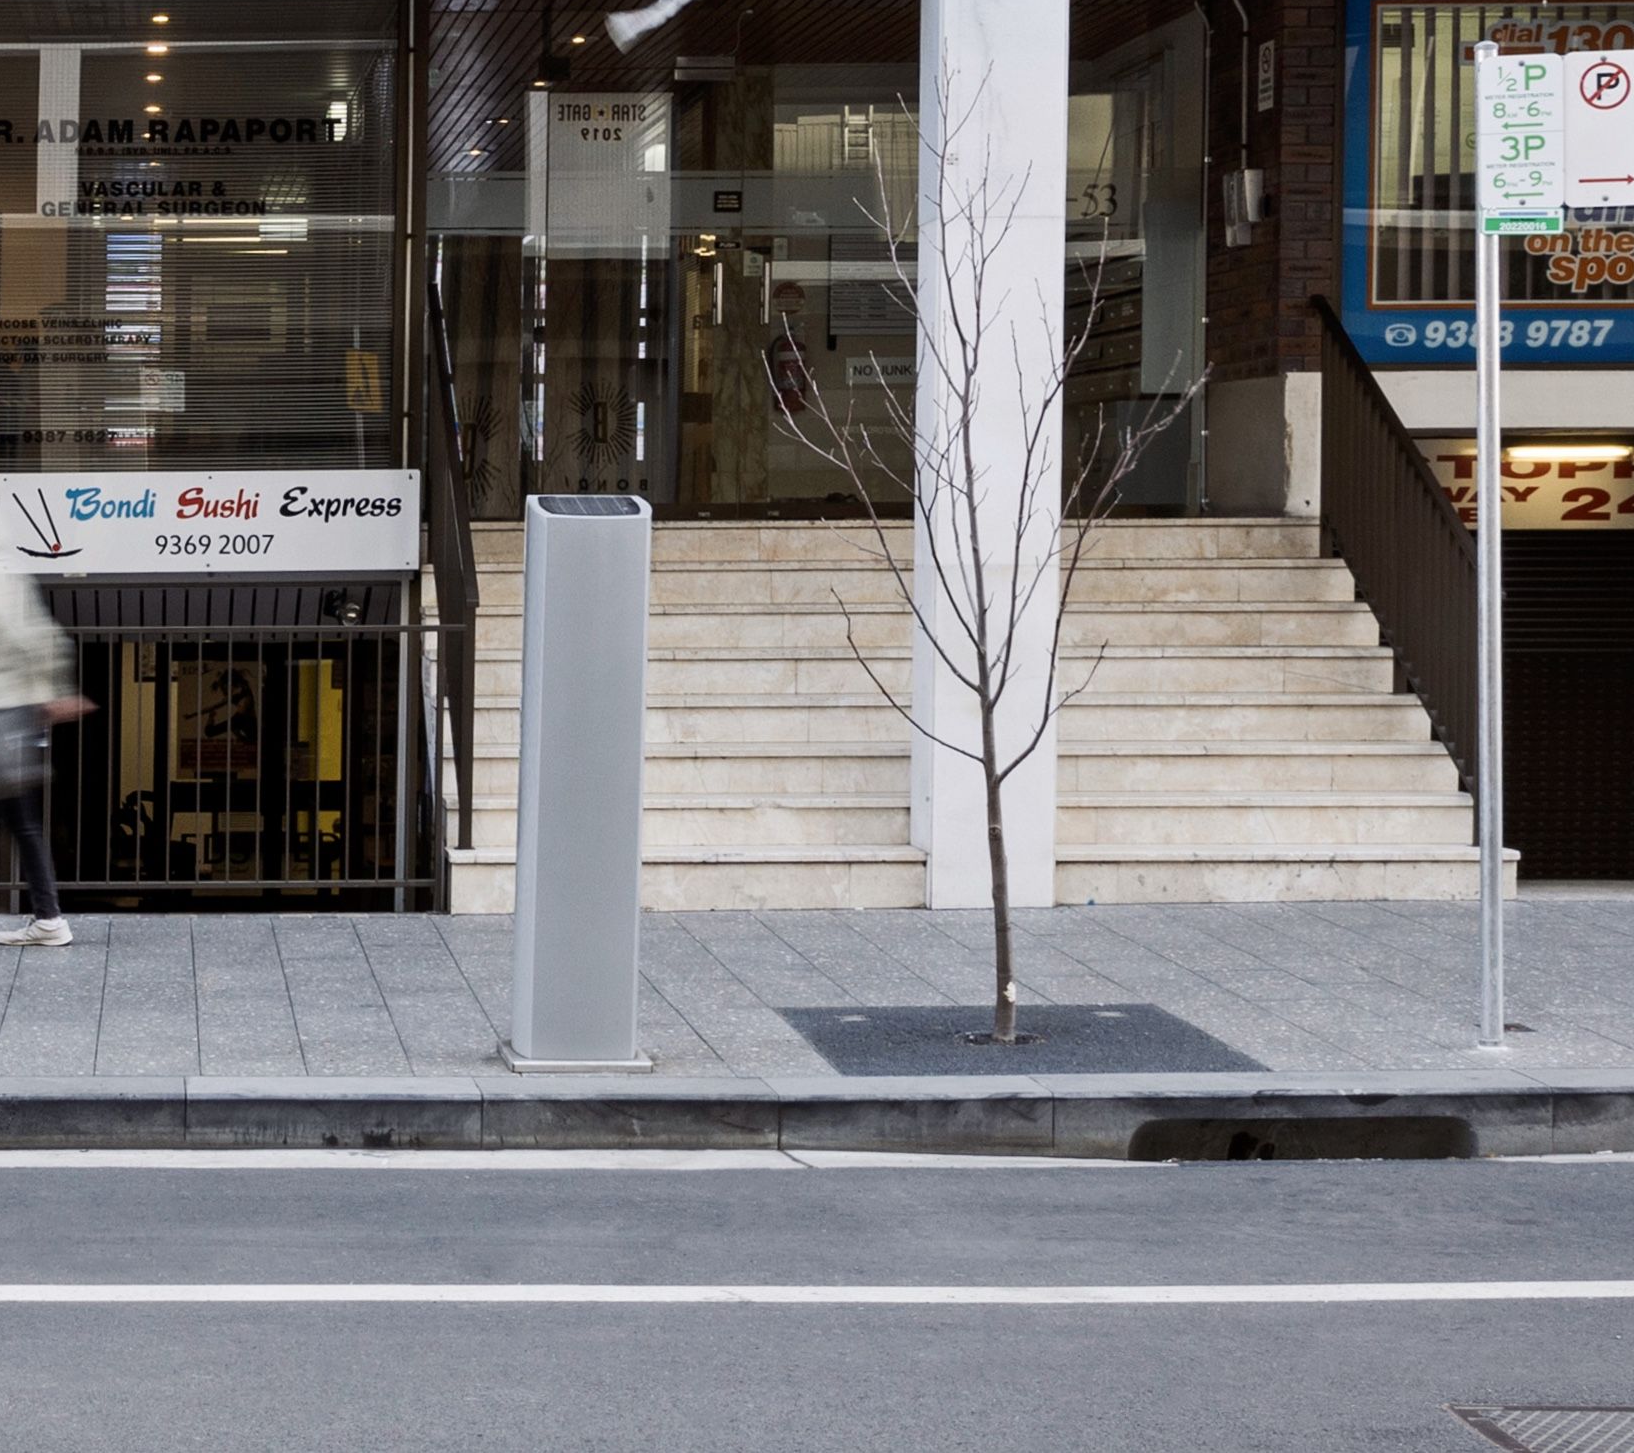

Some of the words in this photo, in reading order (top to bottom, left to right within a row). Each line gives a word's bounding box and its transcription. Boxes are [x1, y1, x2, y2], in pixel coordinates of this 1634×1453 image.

[1490, 25, 1542, 45] dial
[32, 118, 134, 144] ADAM
[148, 117, 343, 143] RAPAPORT
[1499, 134, 1546, 162] 3P
[80, 180, 204, 196] VASCULAR
[211, 181, 226, 196] &
[41, 201, 148, 217] GENERAL
[157, 200, 267, 216] SURGEON
[1526, 232, 1574, 255] on
[41, 319, 80, 329] VEINS
[1525, 319, 1614, 348] 9787
[43, 334, 152, 345] SCLEROTHERAPY
[52, 352, 110, 363] SURGERY
[853, 365, 874, 377] NO
[880, 364, 914, 376] JUNK
[65, 487, 157, 521] Bondi
[176, 486, 260, 521] Sushi
[279, 486, 403, 523] Express
[154, 534, 212, 557] 9369
[218, 534, 275, 556] 2007
